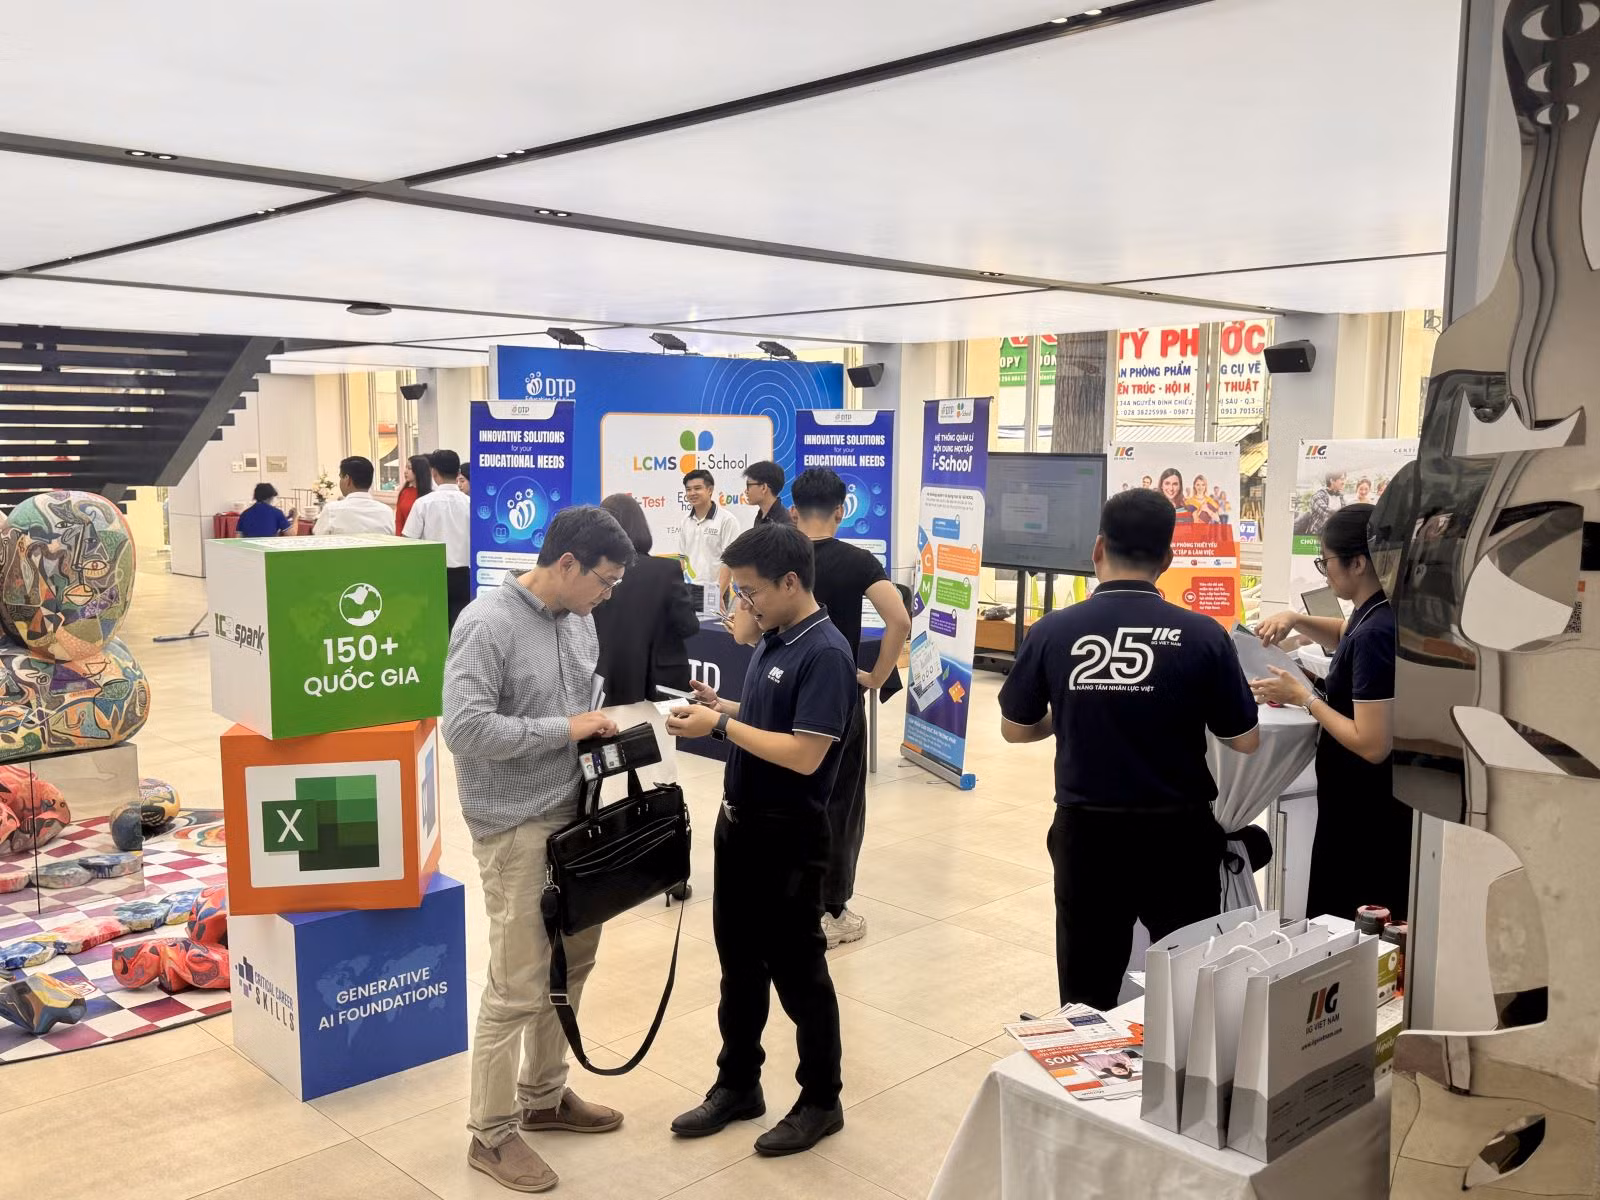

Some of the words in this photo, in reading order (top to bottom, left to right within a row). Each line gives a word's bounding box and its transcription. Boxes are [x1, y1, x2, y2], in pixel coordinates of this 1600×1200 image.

[1130, 364, 1160, 377] PHÒNG
[1164, 361, 1191, 376] PHẨM
[546, 378, 576, 397] DTP
[1131, 381, 1155, 394] TRÚC
[1224, 378, 1259, 394] THUẬT
[479, 430, 522, 443] INNOVATIVE
[523, 431, 565, 444] SOLUTIONS
[804, 434, 846, 445] INNOVATIVE
[846, 434, 886, 446] SOLUTIONS
[479, 453, 536, 468] EDUCATIONAL
[537, 454, 565, 469] NEEDS
[633, 454, 677, 471] LCMS
[804, 454, 858, 467] EDUCATIONAL
[859, 455, 886, 467] NEEDS
[932, 453, 973, 472] i-School
[922, 580, 930, 592] M
[234, 623, 265, 651] spark
[323, 634, 399, 665] 150+
[1068, 627, 1155, 691] 25
[303, 665, 375, 697] QUỐC
[380, 666, 420, 686] GIA
[276, 808, 304, 843] X
[336, 966, 431, 1005] GENERATIVE
[255, 986, 295, 1032] SKILLS
[318, 1009, 335, 1031] AI
[338, 981, 448, 1026] FOUNDATIONS
[1314, 1018, 1326, 1031] VIET
[1327, 1012, 1340, 1025] NAM
[1045, 1053, 1079, 1066] MOS
